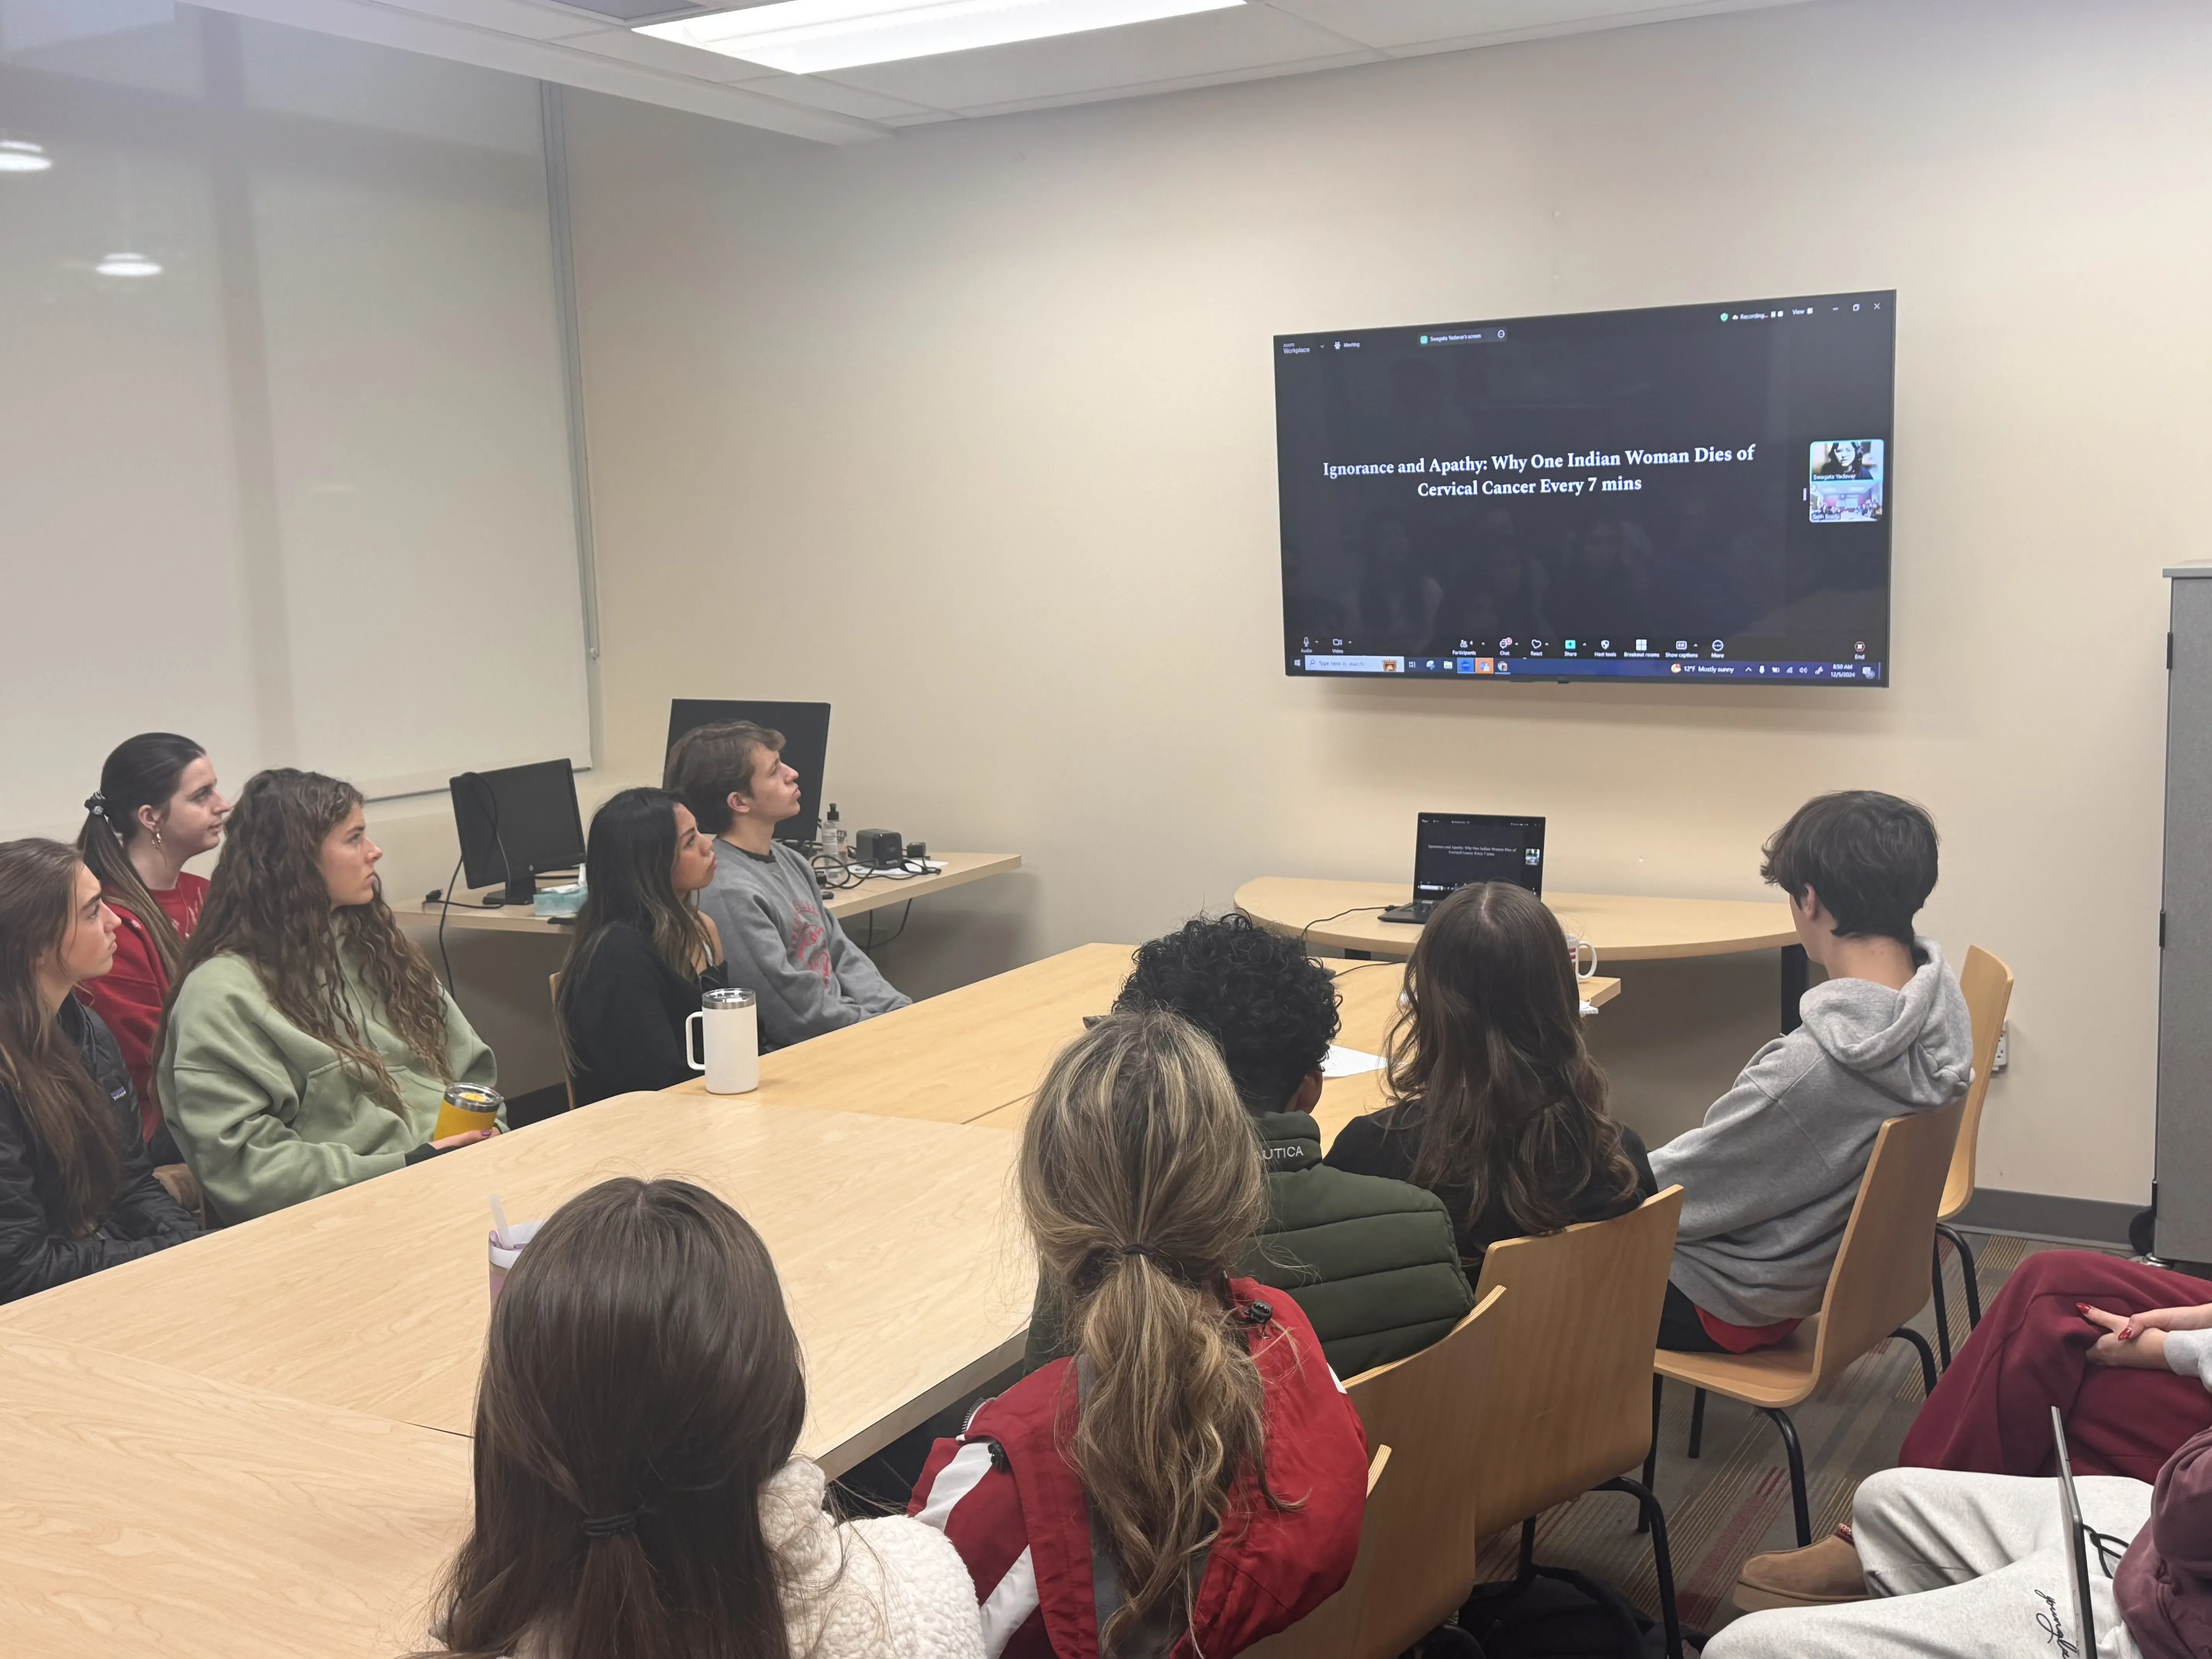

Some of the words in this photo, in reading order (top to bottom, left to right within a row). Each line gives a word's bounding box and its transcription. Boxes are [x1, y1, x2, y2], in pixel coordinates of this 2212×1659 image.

[1323, 462, 1395, 479] Ignorance
[1397, 457, 1425, 473] and
[1428, 455, 1488, 476] Apathy:
[1491, 453, 1528, 473] Why
[1531, 454, 1563, 469] One
[1567, 450, 1621, 467] Indian
[1625, 449, 1690, 465] Woman
[1694, 446, 1732, 463] Dies
[1736, 443, 1757, 461] of
[1417, 480, 1478, 497] Cervical
[1482, 480, 1536, 495] Cancer
[1540, 478, 1585, 496] Every
[1588, 477, 1597, 492] 7
[1602, 475, 1642, 491] mins
[1262, 1146, 1304, 1160] UTICA
